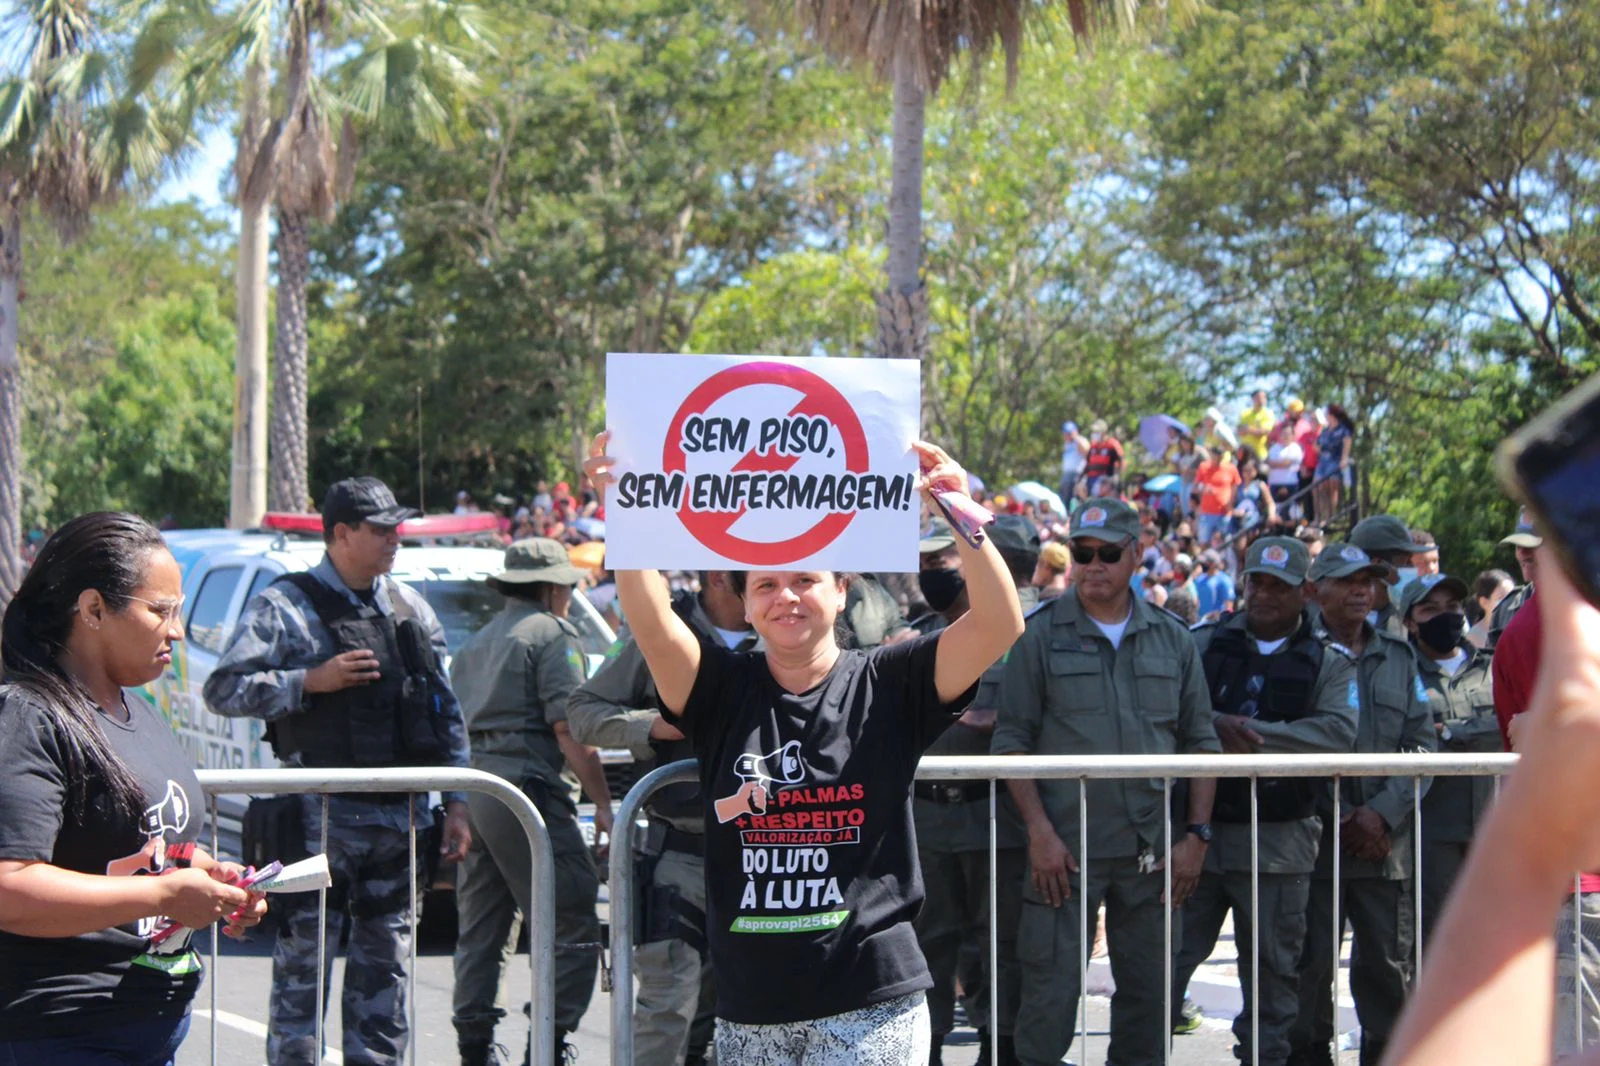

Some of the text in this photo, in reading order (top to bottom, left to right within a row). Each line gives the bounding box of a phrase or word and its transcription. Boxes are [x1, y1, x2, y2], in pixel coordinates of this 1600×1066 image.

[682, 416, 836, 459] SEM PISO,
[617, 471, 915, 512] SEM ENFERMAGEM!
[777, 783, 865, 807] PALMAS
[750, 808, 865, 829] RESPEITO
[742, 848, 829, 873] DO LUTO
[740, 874, 844, 909] À LUTA
[737, 914, 840, 932] #aprovapl2564
